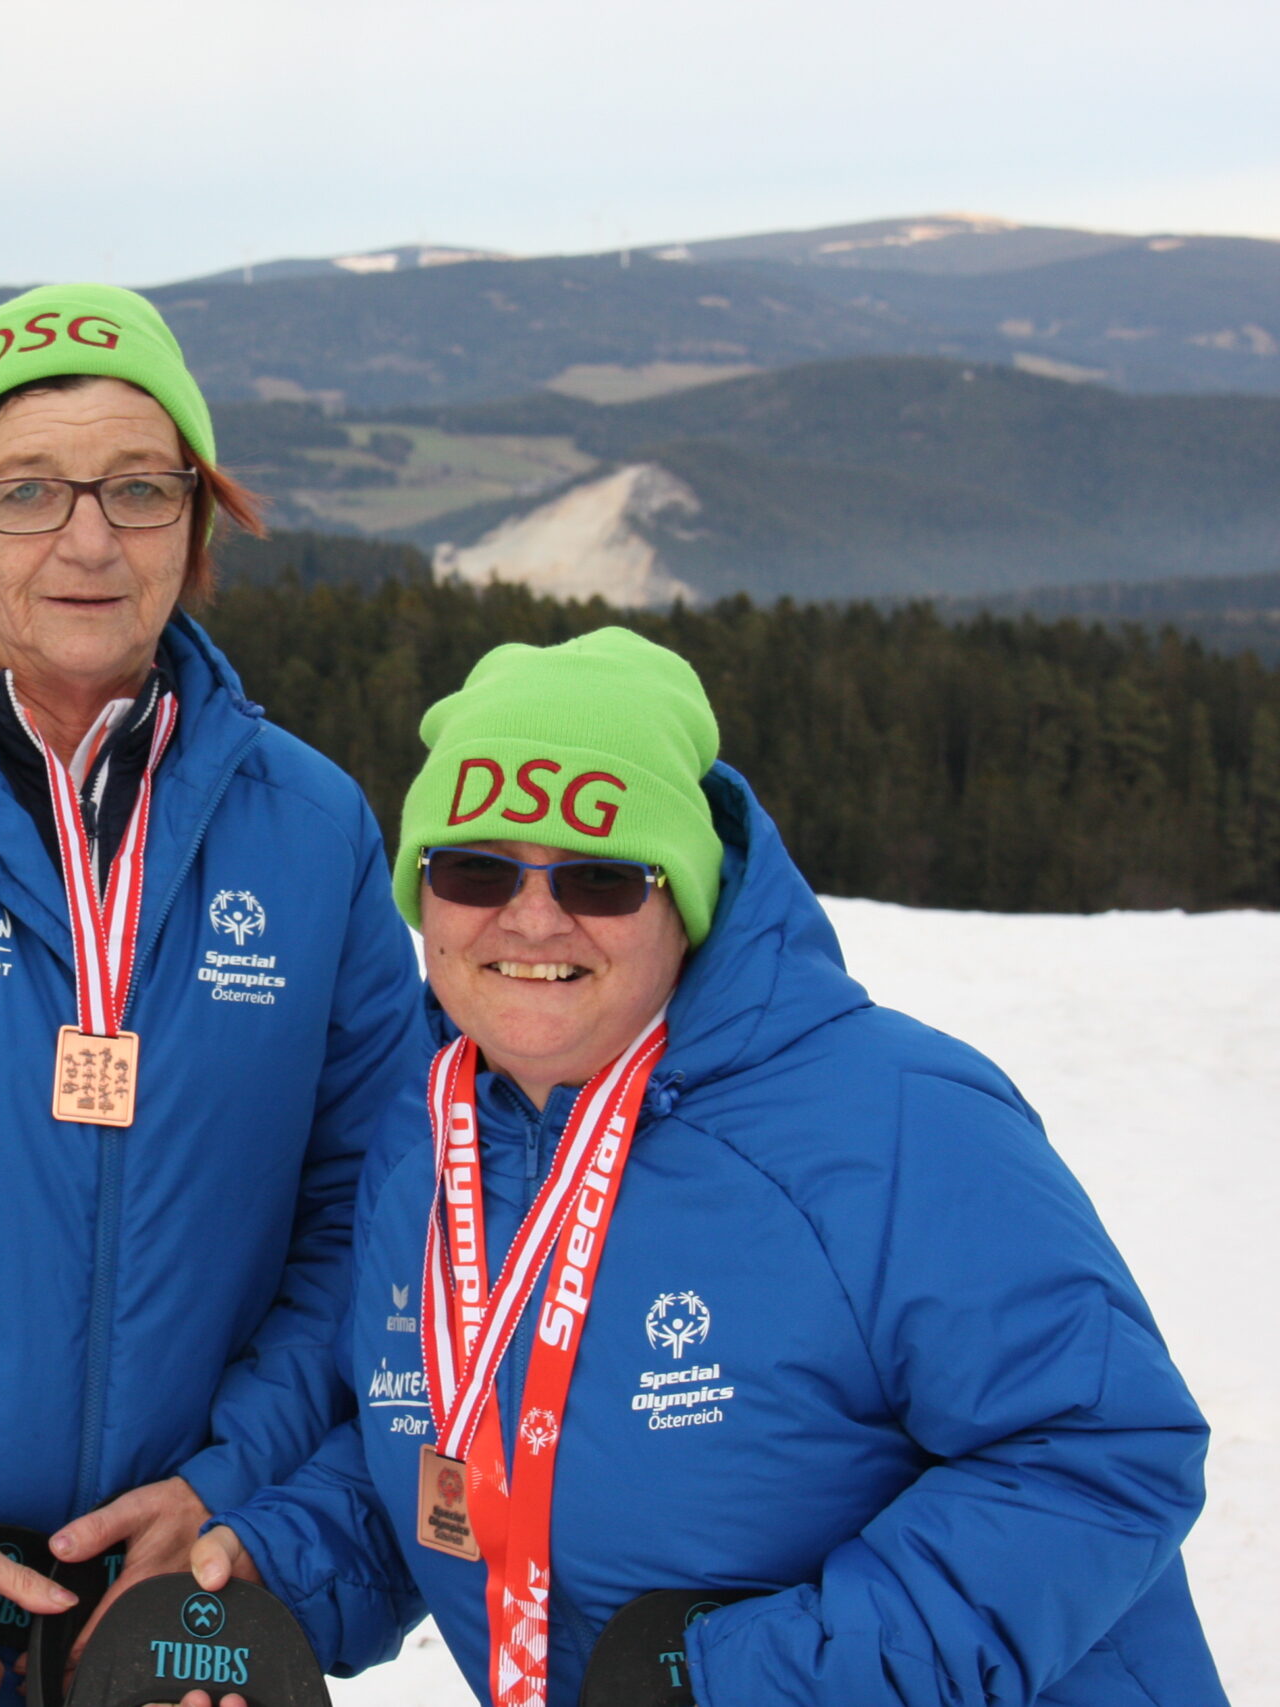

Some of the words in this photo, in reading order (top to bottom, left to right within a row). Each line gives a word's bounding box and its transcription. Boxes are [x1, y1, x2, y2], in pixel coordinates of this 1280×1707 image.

[447, 758, 627, 837] DSG
[205, 950, 276, 969] Special
[197, 967, 286, 988] Olympics
[211, 984, 275, 1005] Österreich
[386, 1313, 417, 1333] erima
[639, 1363, 720, 1390] Special
[631, 1386, 735, 1412] Olympics
[390, 1414, 430, 1435] SPORT
[648, 1406, 723, 1430] Österreich
[150, 1640, 249, 1685] TUBBS
